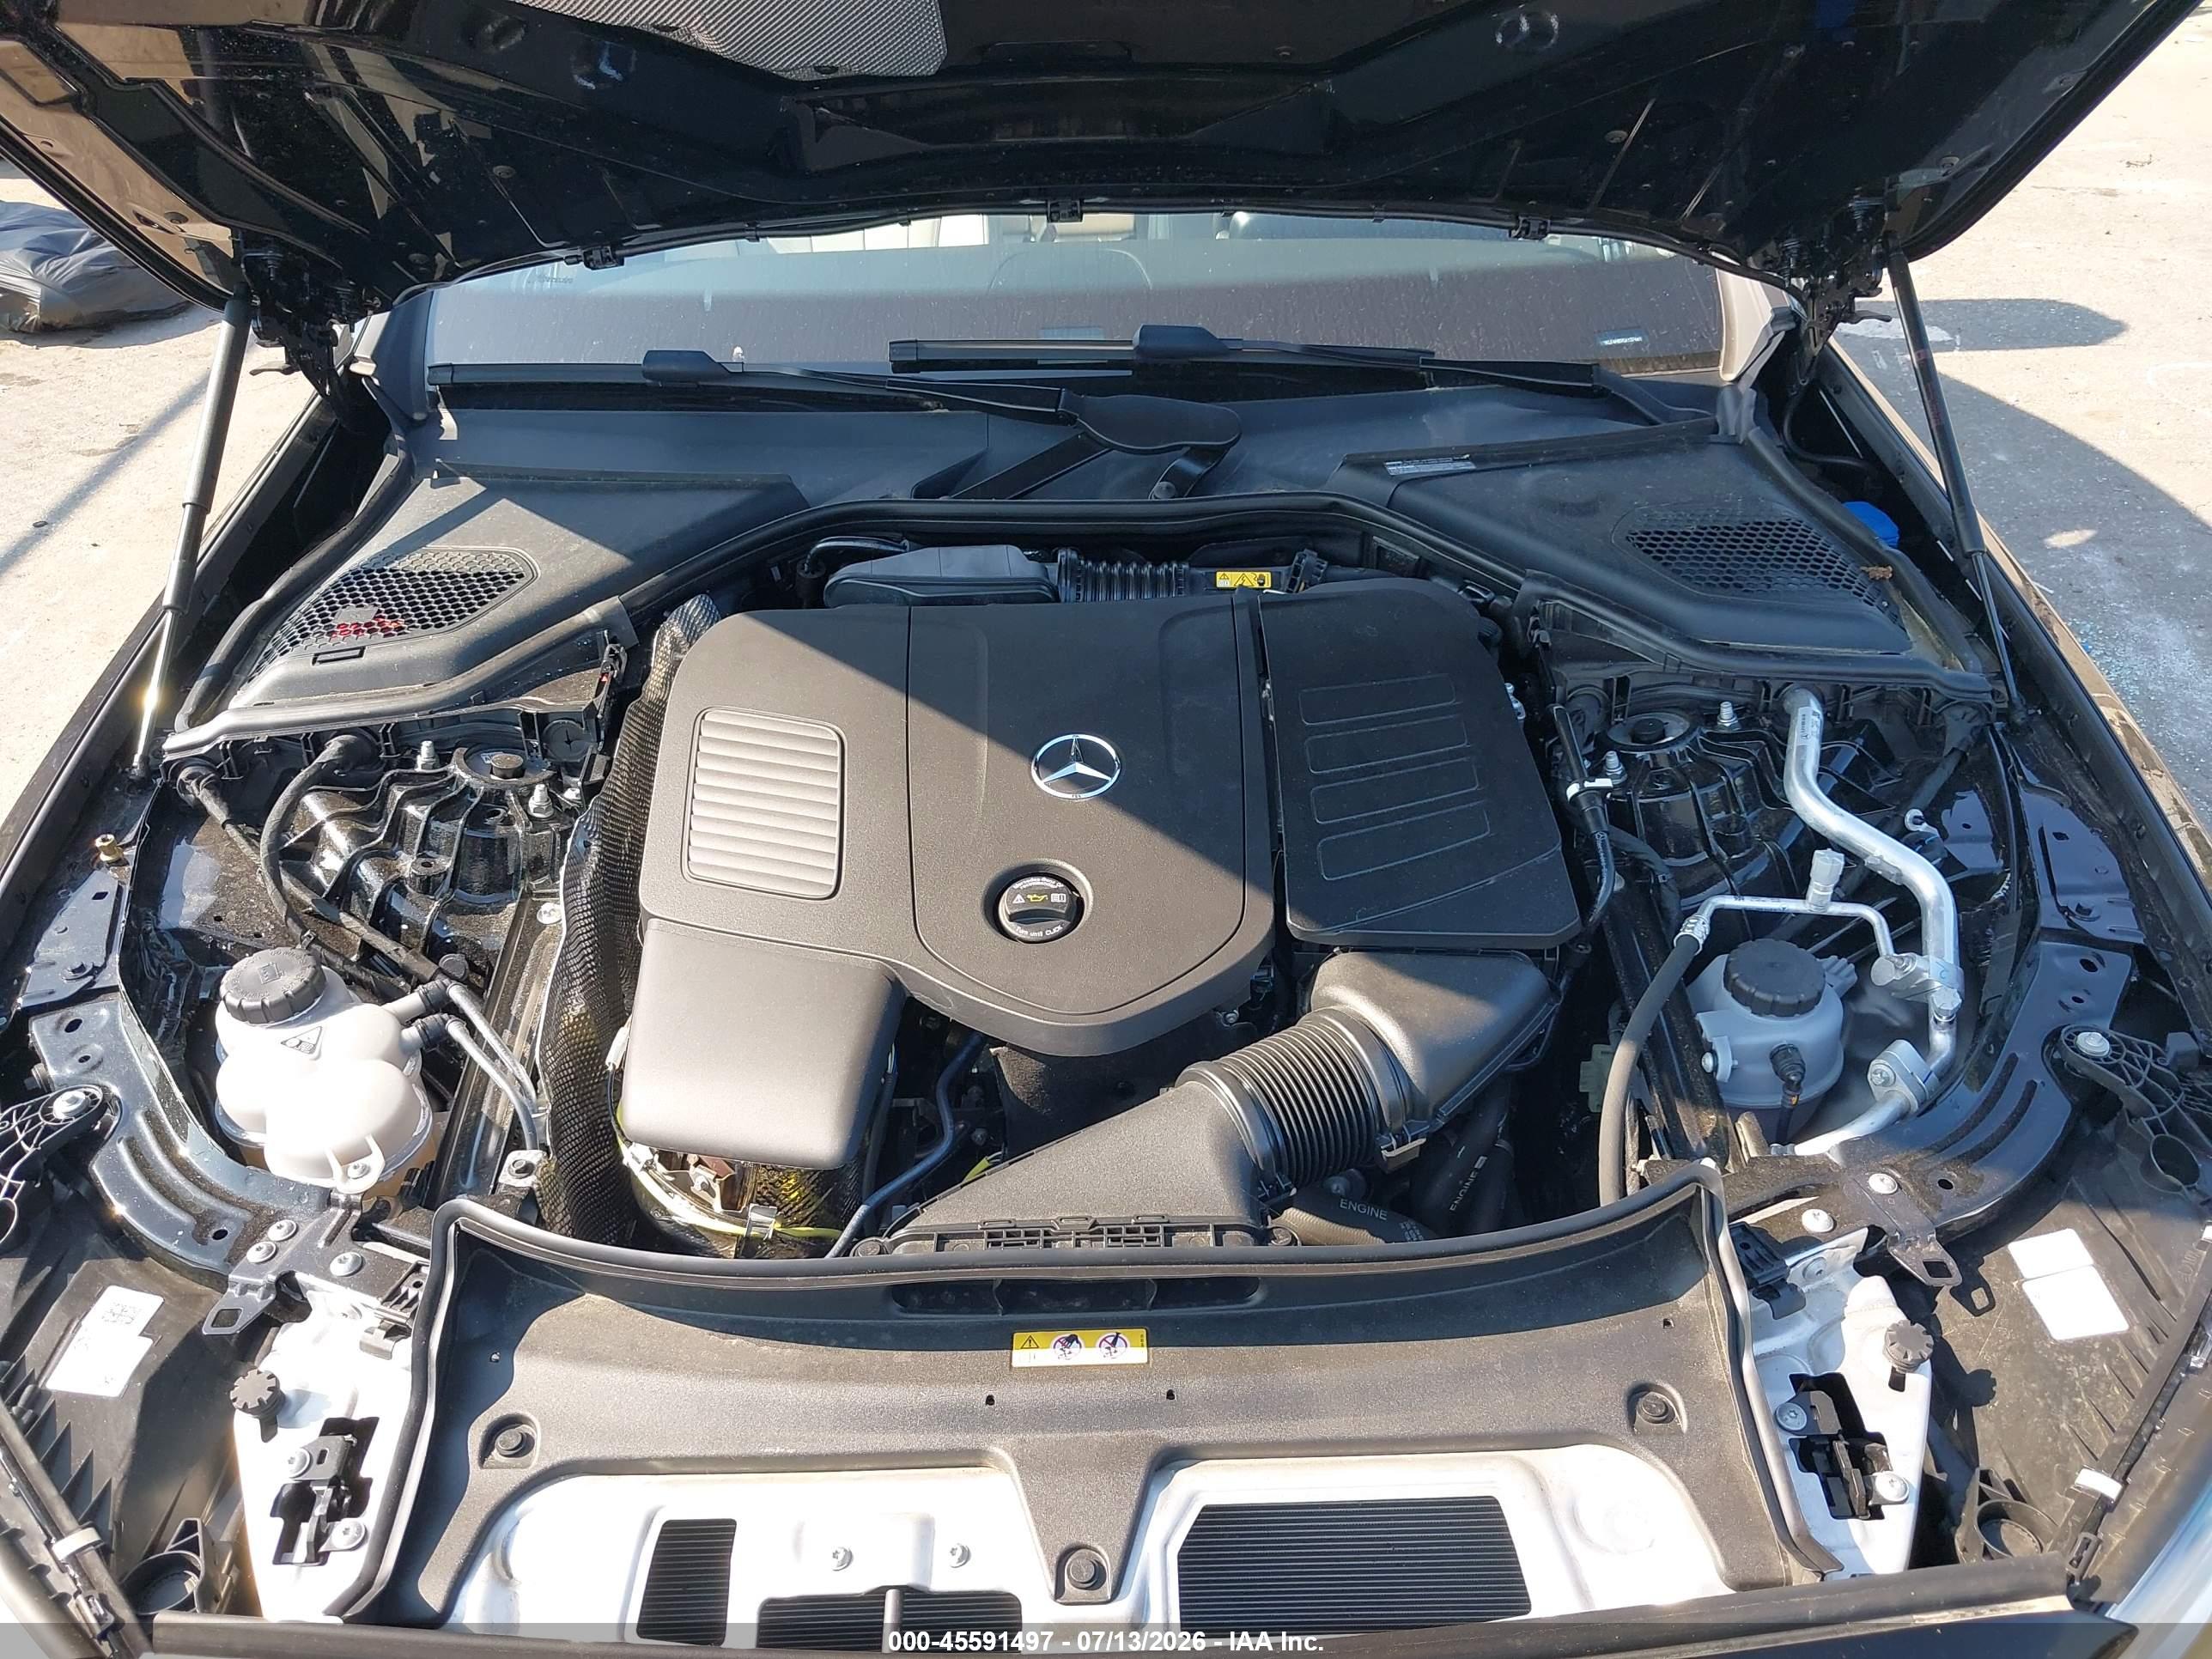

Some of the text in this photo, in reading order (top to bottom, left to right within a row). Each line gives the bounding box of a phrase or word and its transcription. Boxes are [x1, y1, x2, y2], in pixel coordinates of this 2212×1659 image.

[1016, 926, 1029, 935] Turn
[1449, 1170, 1479, 1211] ENGINE
[1340, 1198, 1389, 1220] ENGINE
